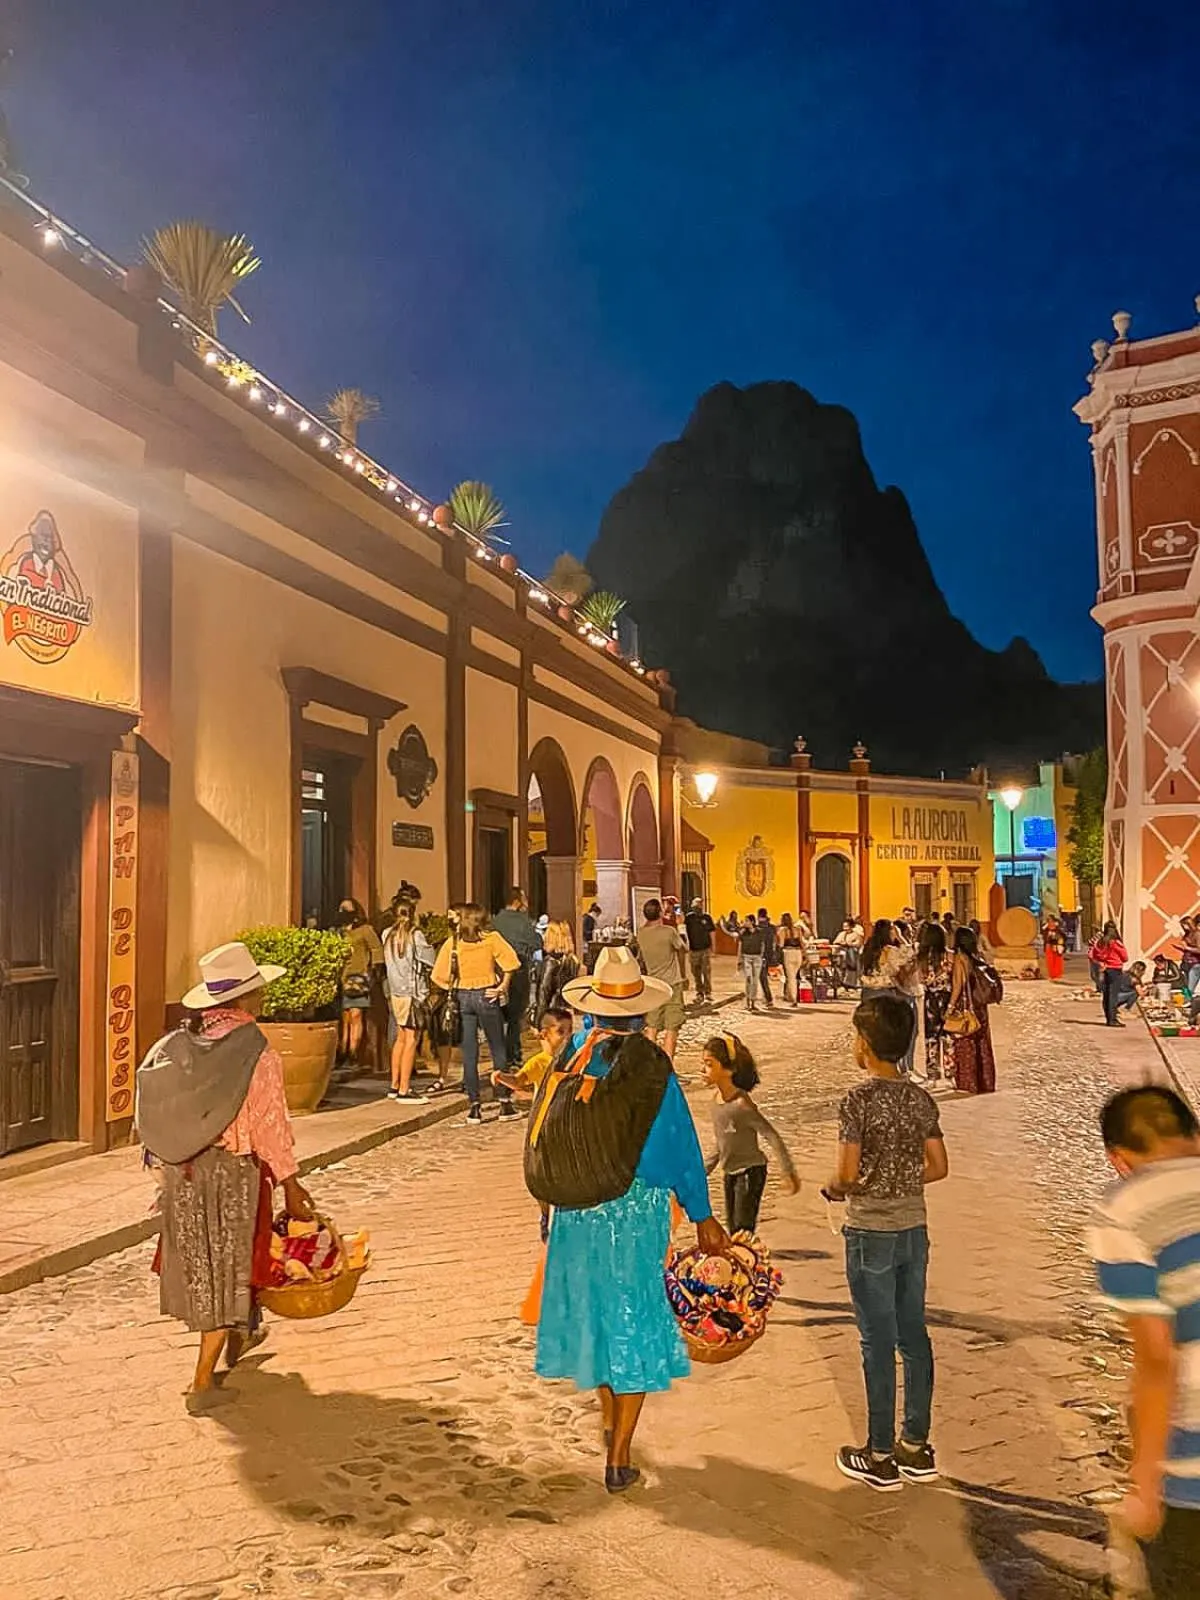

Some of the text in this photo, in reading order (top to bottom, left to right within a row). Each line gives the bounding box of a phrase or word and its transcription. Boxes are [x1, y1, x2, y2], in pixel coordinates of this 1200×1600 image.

[0, 579, 91, 622] an Tradicional
[12, 613, 68, 641] EL NEGRITO
[114, 805, 135, 878] PAN
[892, 806, 968, 842] LA AURORA
[876, 844, 982, 861] CENTRO ARTESANAL
[111, 907, 133, 956] DE
[109, 984, 134, 1113] QUESO
